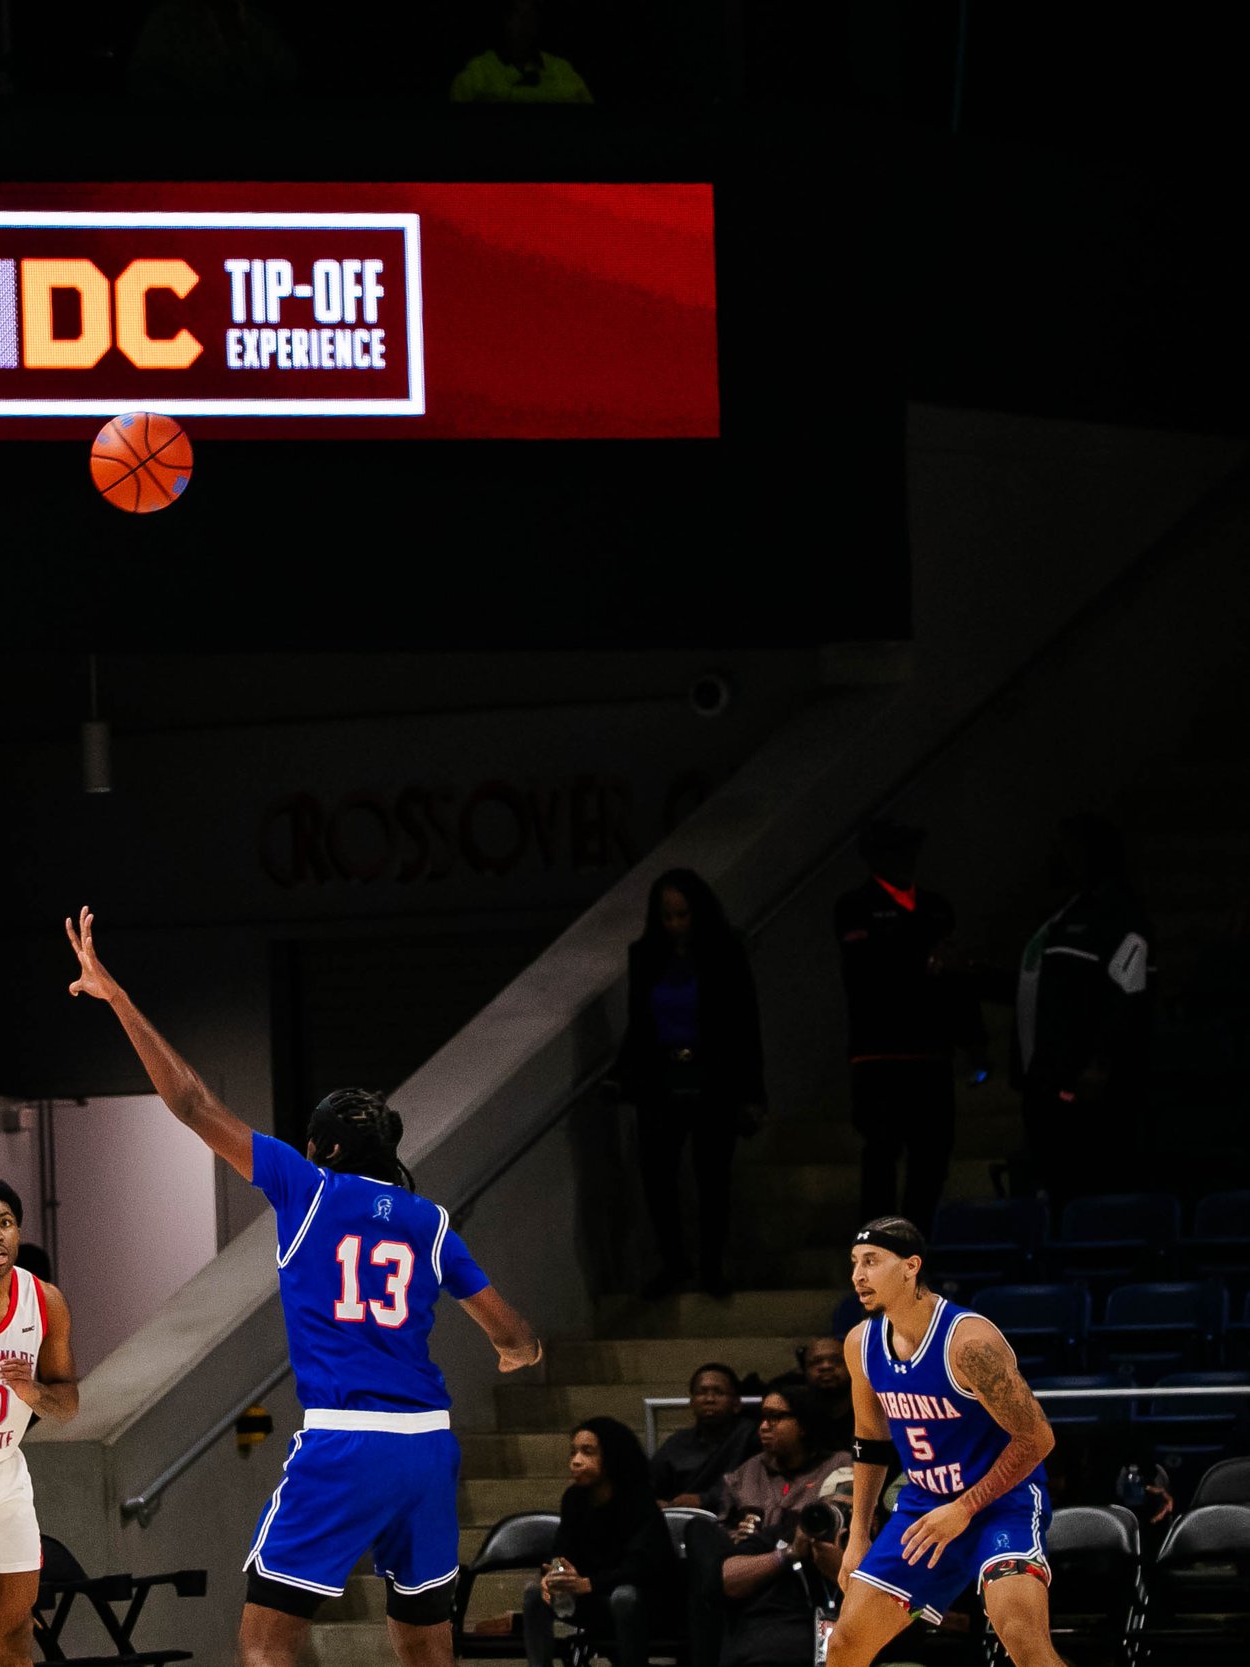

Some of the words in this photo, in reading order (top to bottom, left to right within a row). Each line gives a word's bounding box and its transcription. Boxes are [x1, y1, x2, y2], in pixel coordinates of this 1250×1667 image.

[224, 259, 385, 324] TIP-OFF
[226, 328, 387, 369] EXPERIENCE
[334, 1234, 415, 1330] 13
[905, 1426, 936, 1462] 5
